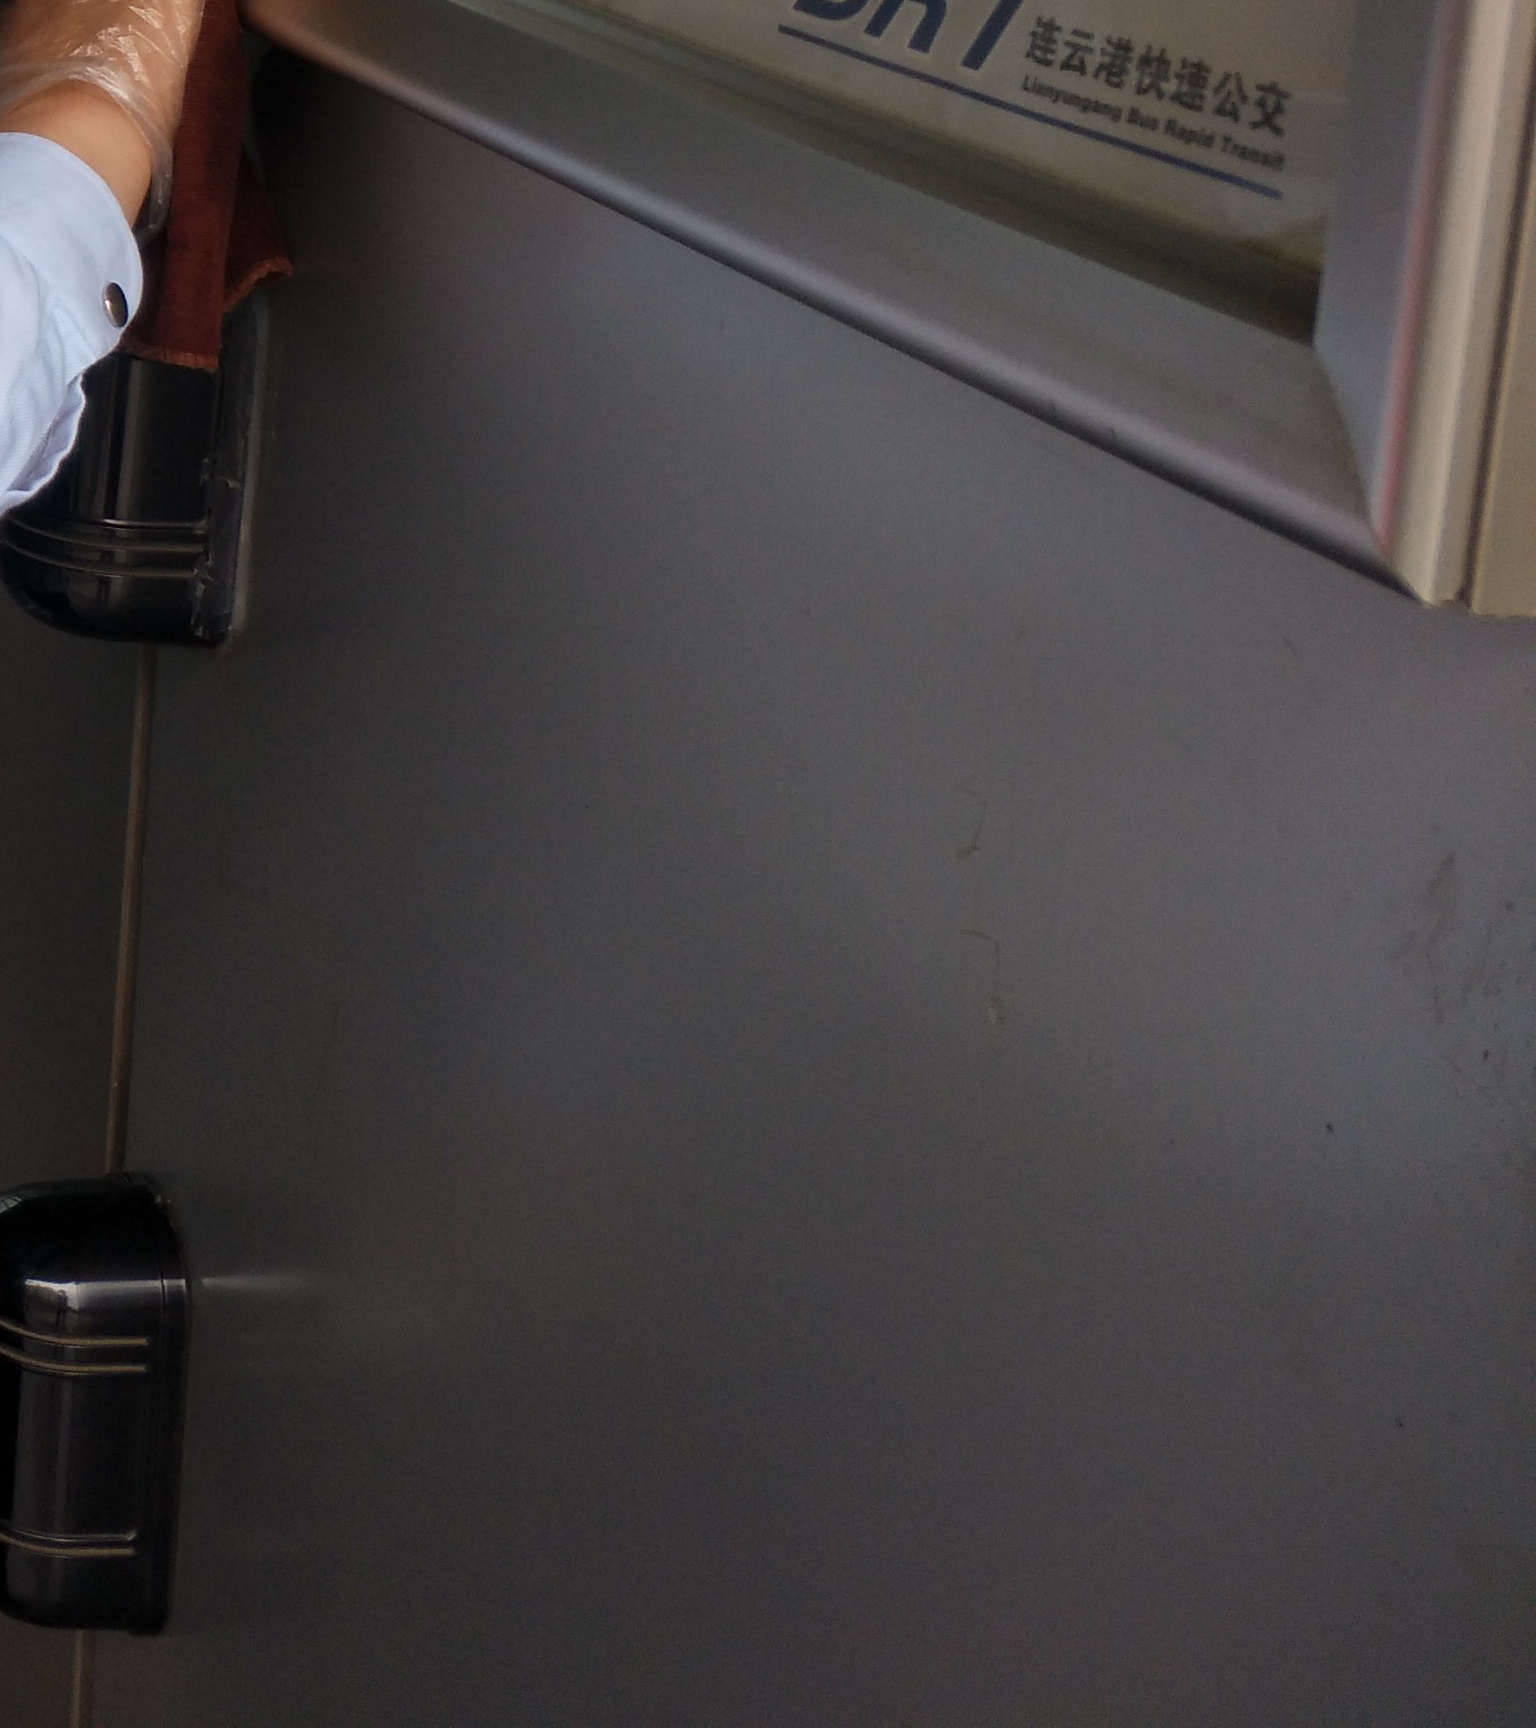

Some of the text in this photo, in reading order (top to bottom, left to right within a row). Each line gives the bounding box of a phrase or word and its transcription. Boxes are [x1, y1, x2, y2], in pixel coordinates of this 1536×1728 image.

[1025, 16, 1290, 138] 连云港快速公交
[1163, 116, 1216, 153] Rapid
[1220, 131, 1285, 171] Transit
